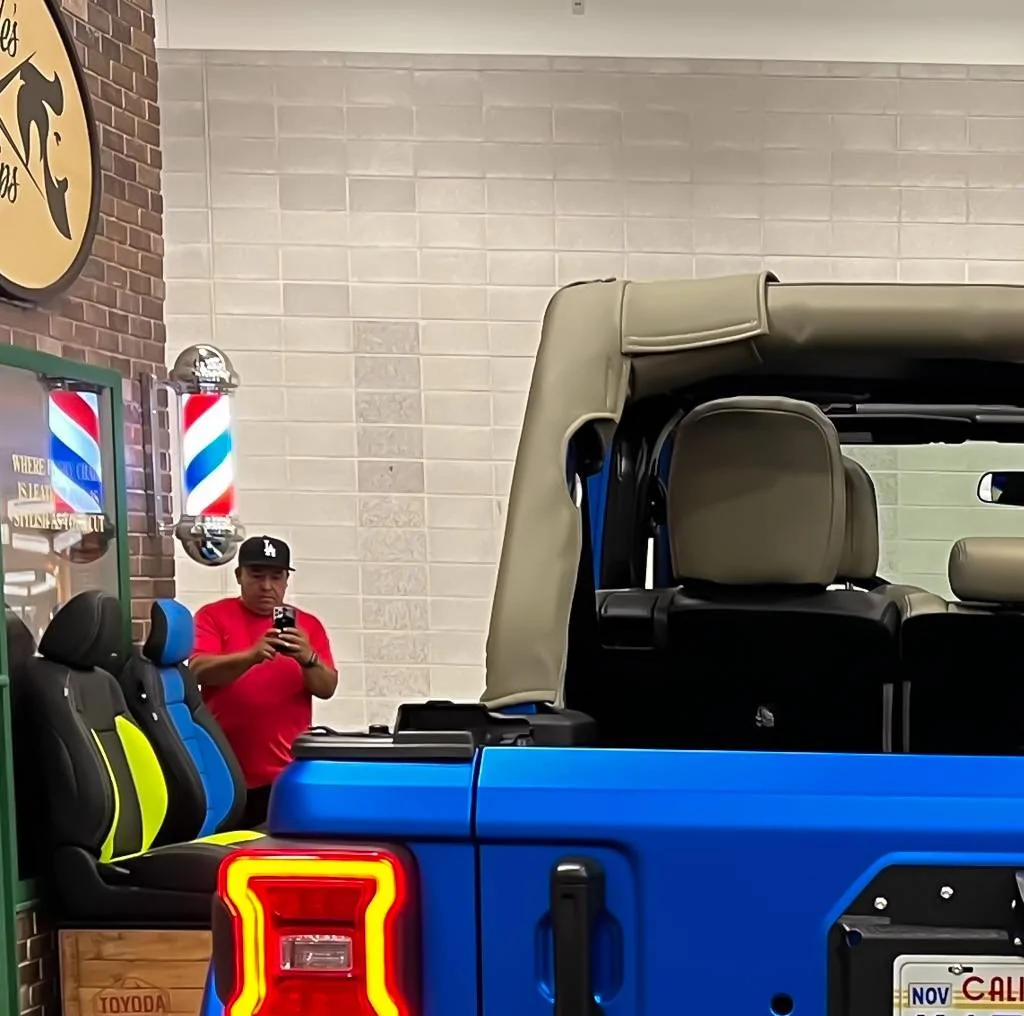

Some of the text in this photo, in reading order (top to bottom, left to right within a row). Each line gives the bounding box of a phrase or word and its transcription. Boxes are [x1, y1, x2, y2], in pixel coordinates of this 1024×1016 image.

[12, 454, 45, 476] WHERE
[264, 540, 276, 557] LA
[99, 994, 166, 1014] TOYODA
[912, 987, 950, 1006] NOV
